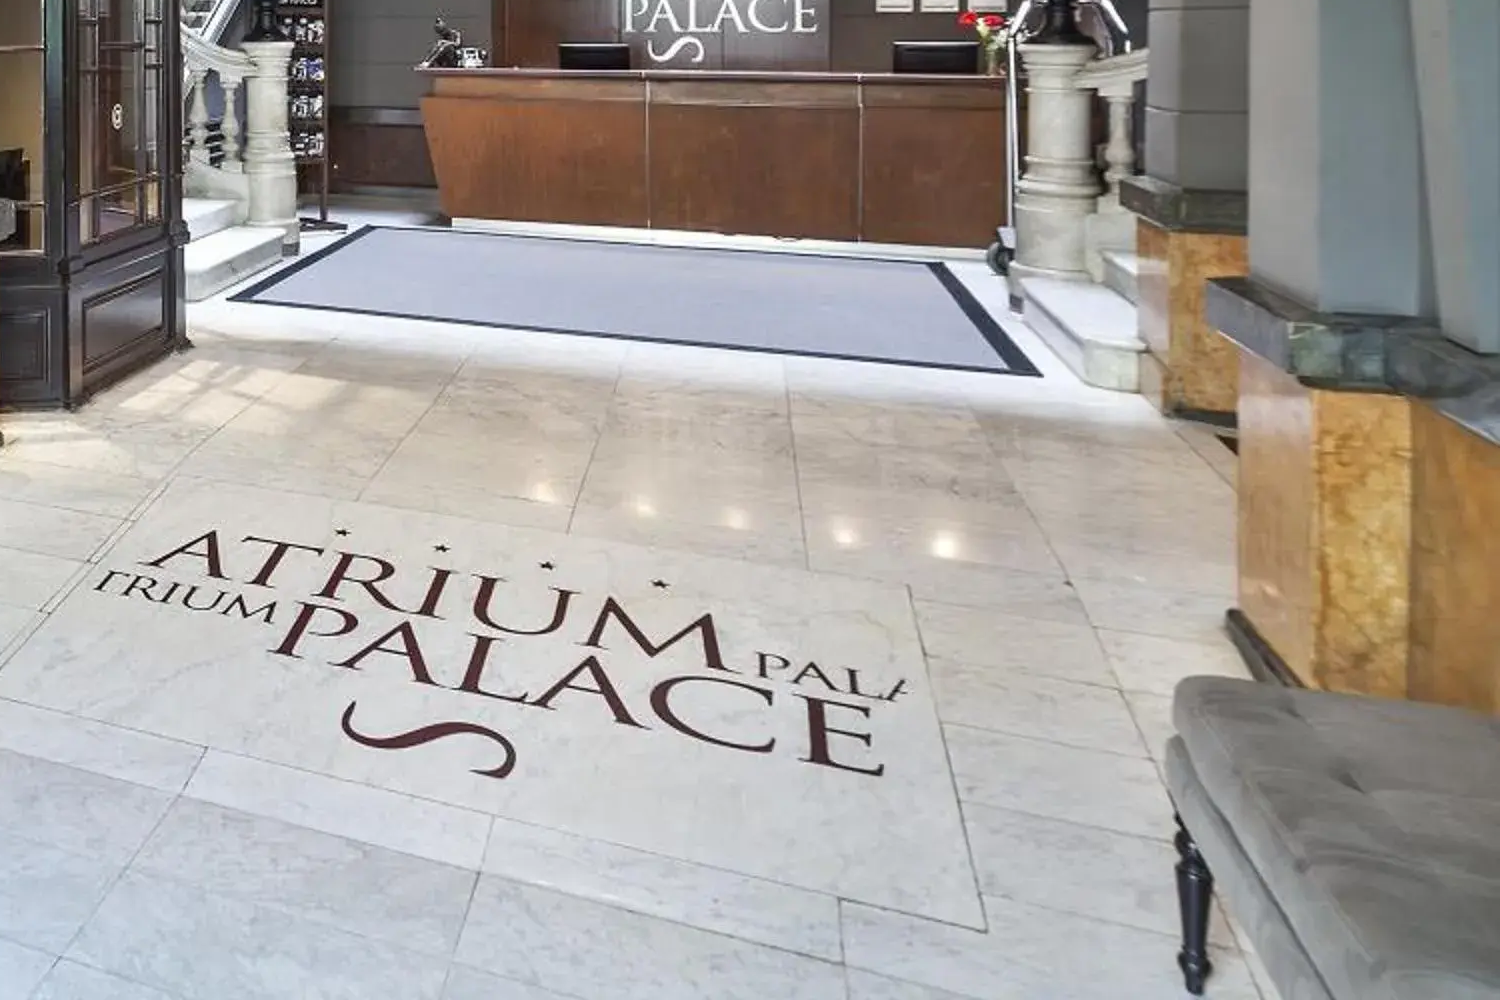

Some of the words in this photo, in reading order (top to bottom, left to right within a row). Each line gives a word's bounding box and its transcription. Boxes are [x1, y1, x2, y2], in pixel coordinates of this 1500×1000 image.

[93, 569, 278, 625] TRIUM
[146, 528, 748, 674] ATRIUM
[266, 601, 886, 778] PALACE
